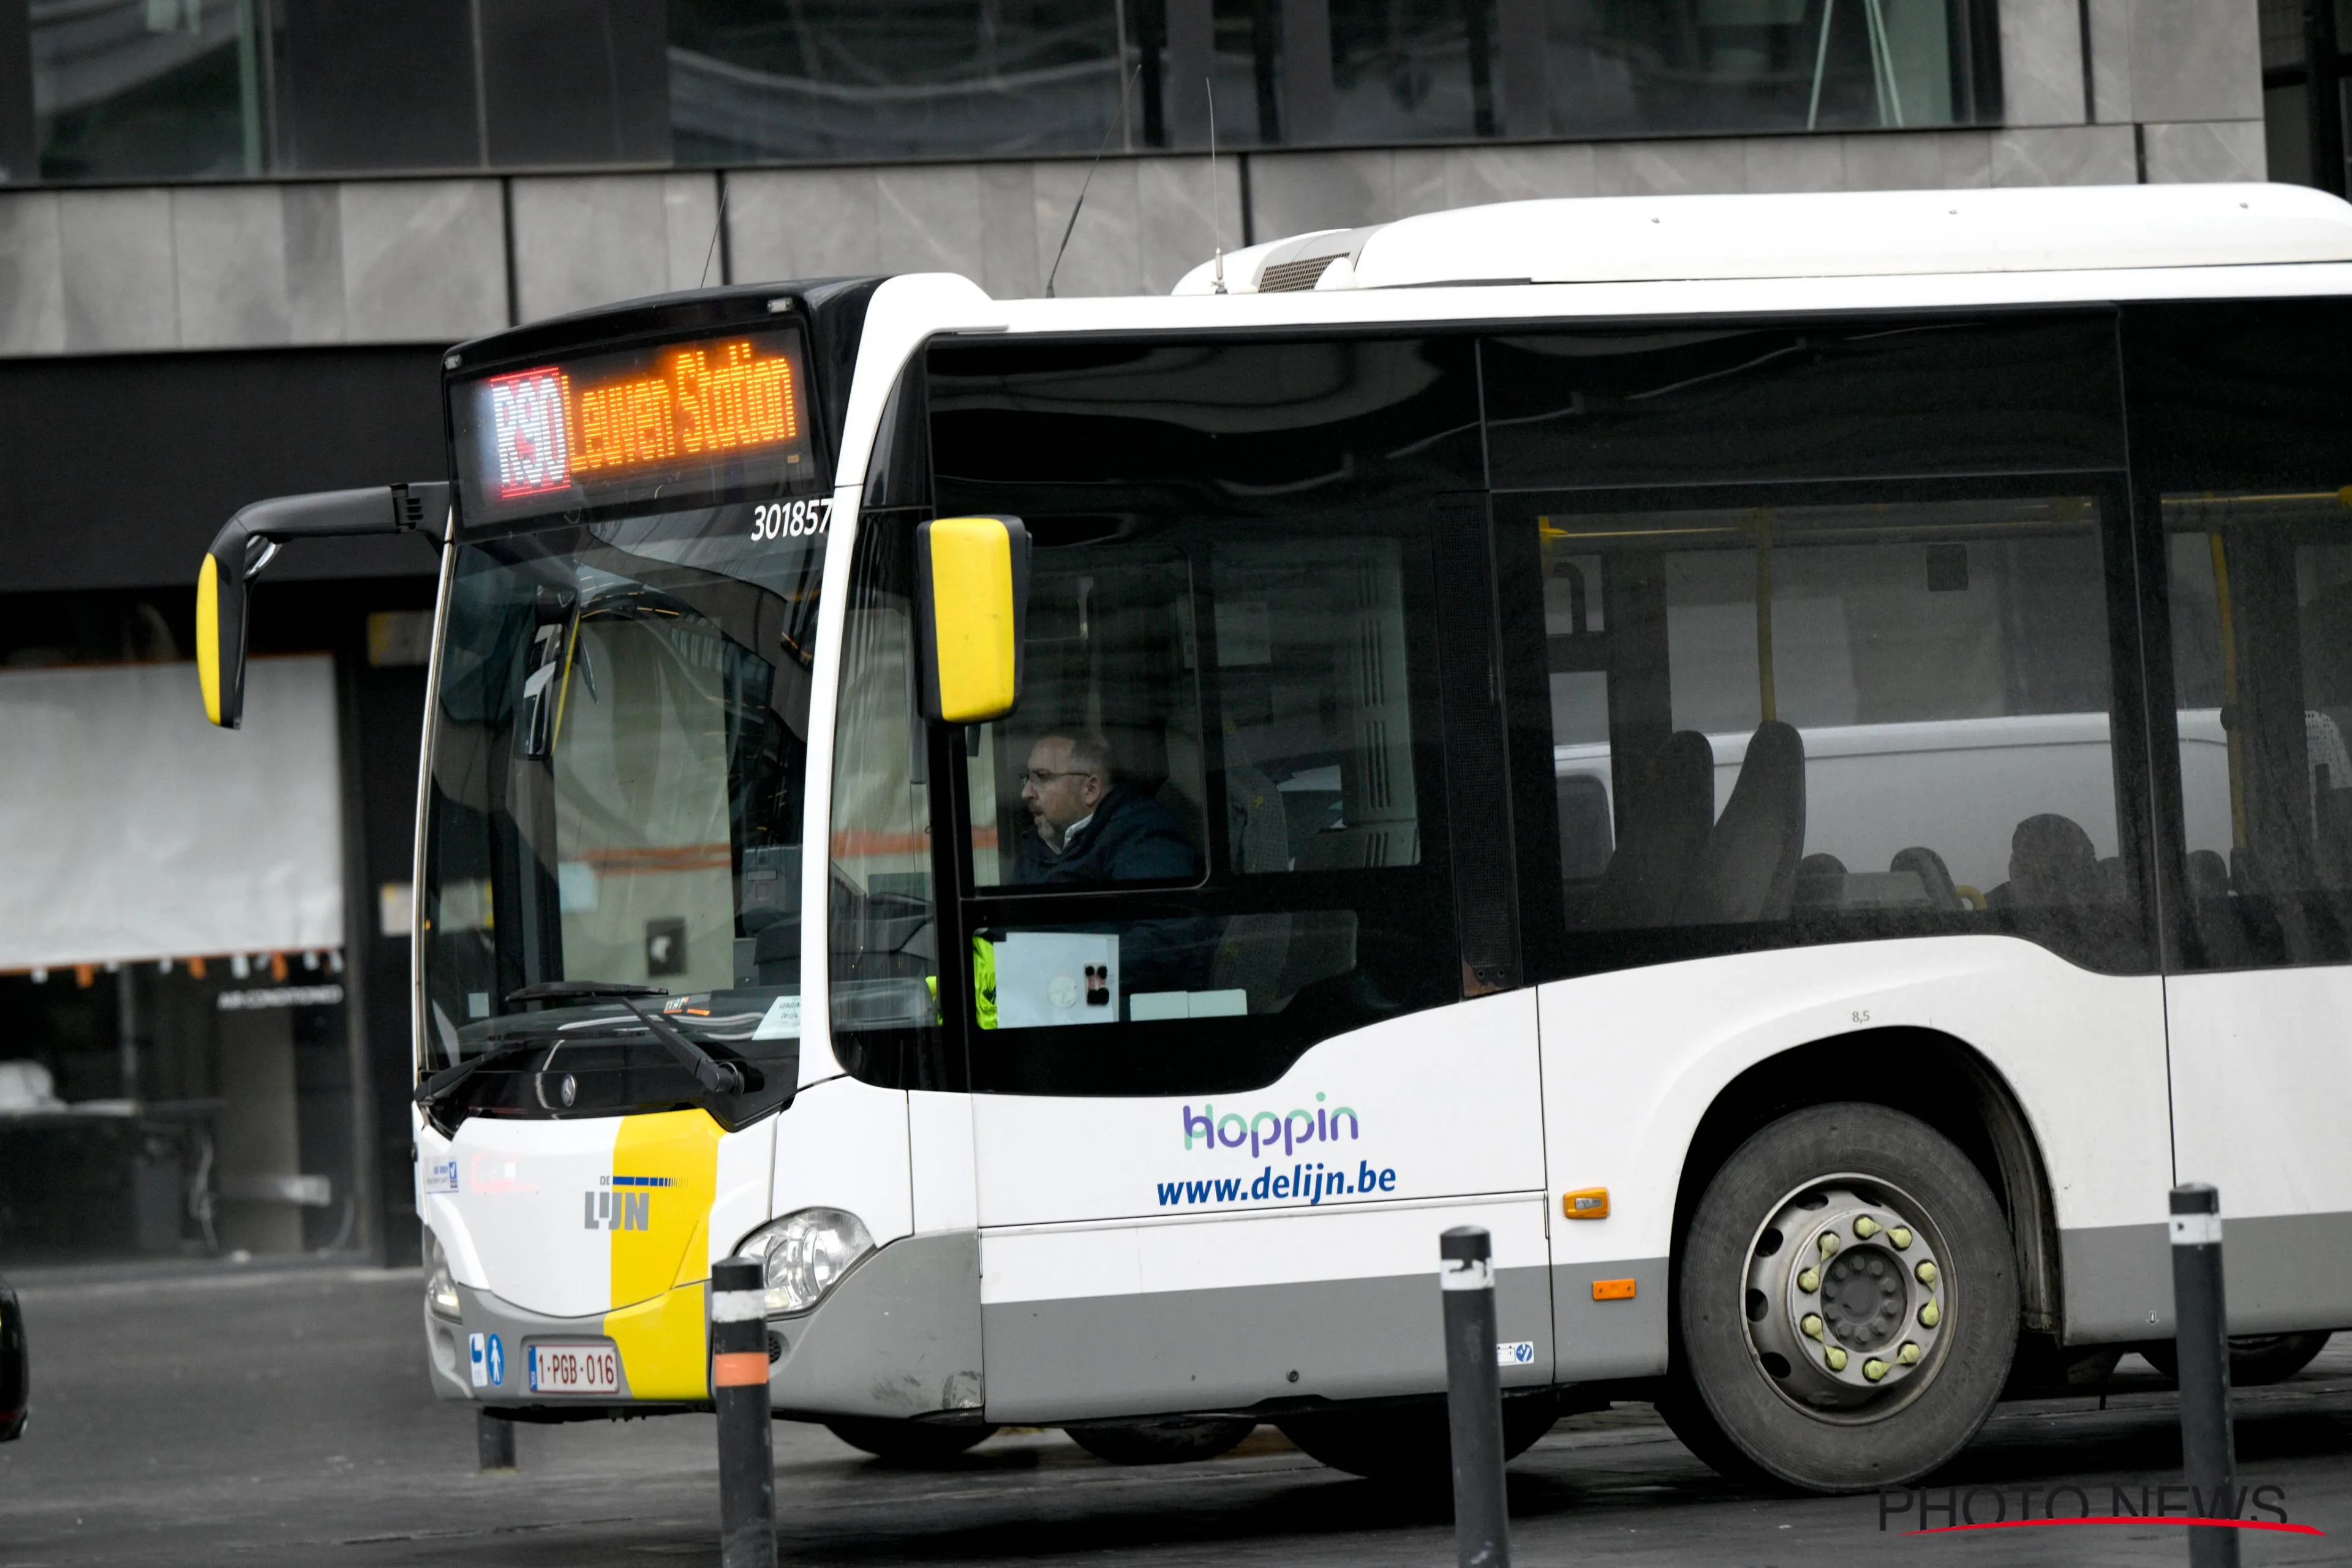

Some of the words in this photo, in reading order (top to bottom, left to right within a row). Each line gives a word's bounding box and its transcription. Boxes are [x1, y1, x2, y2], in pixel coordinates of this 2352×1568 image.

[562, 375, 675, 472] Leuven
[676, 342, 796, 452] Station
[751, 498, 834, 541] 301857
[1852, 1010, 1870, 1023] 8,5
[600, 1176, 610, 1185] DE
[1157, 1159, 1396, 1205] www.delijn.be
[539, 1354, 614, 1384] 1-PGB-016
